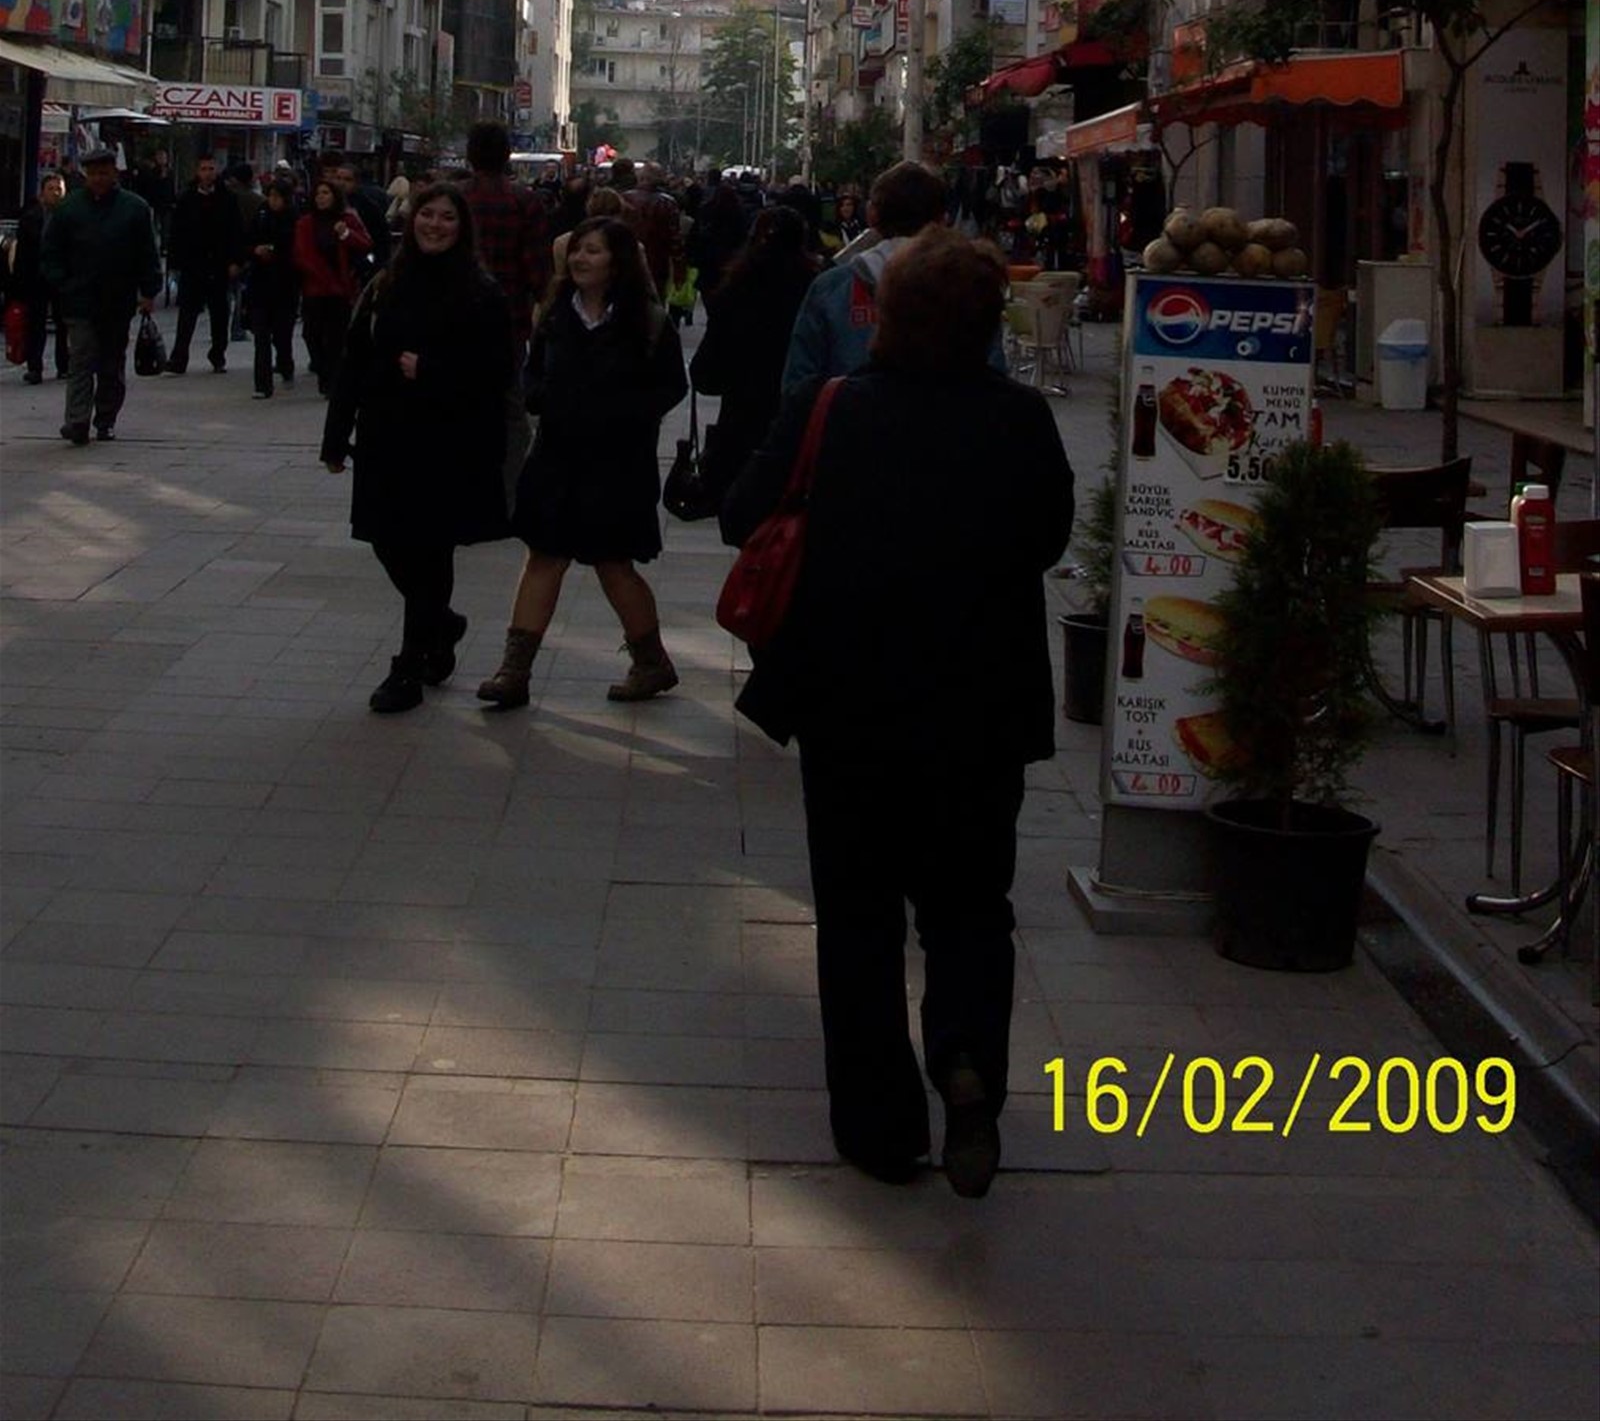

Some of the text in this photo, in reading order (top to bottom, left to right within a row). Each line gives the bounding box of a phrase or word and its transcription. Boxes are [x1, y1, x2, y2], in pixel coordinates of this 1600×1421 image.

[1208, 308, 1306, 335] PEPSI
[1125, 710, 1157, 724] TOST
[1111, 752, 1170, 766] ALATASI
